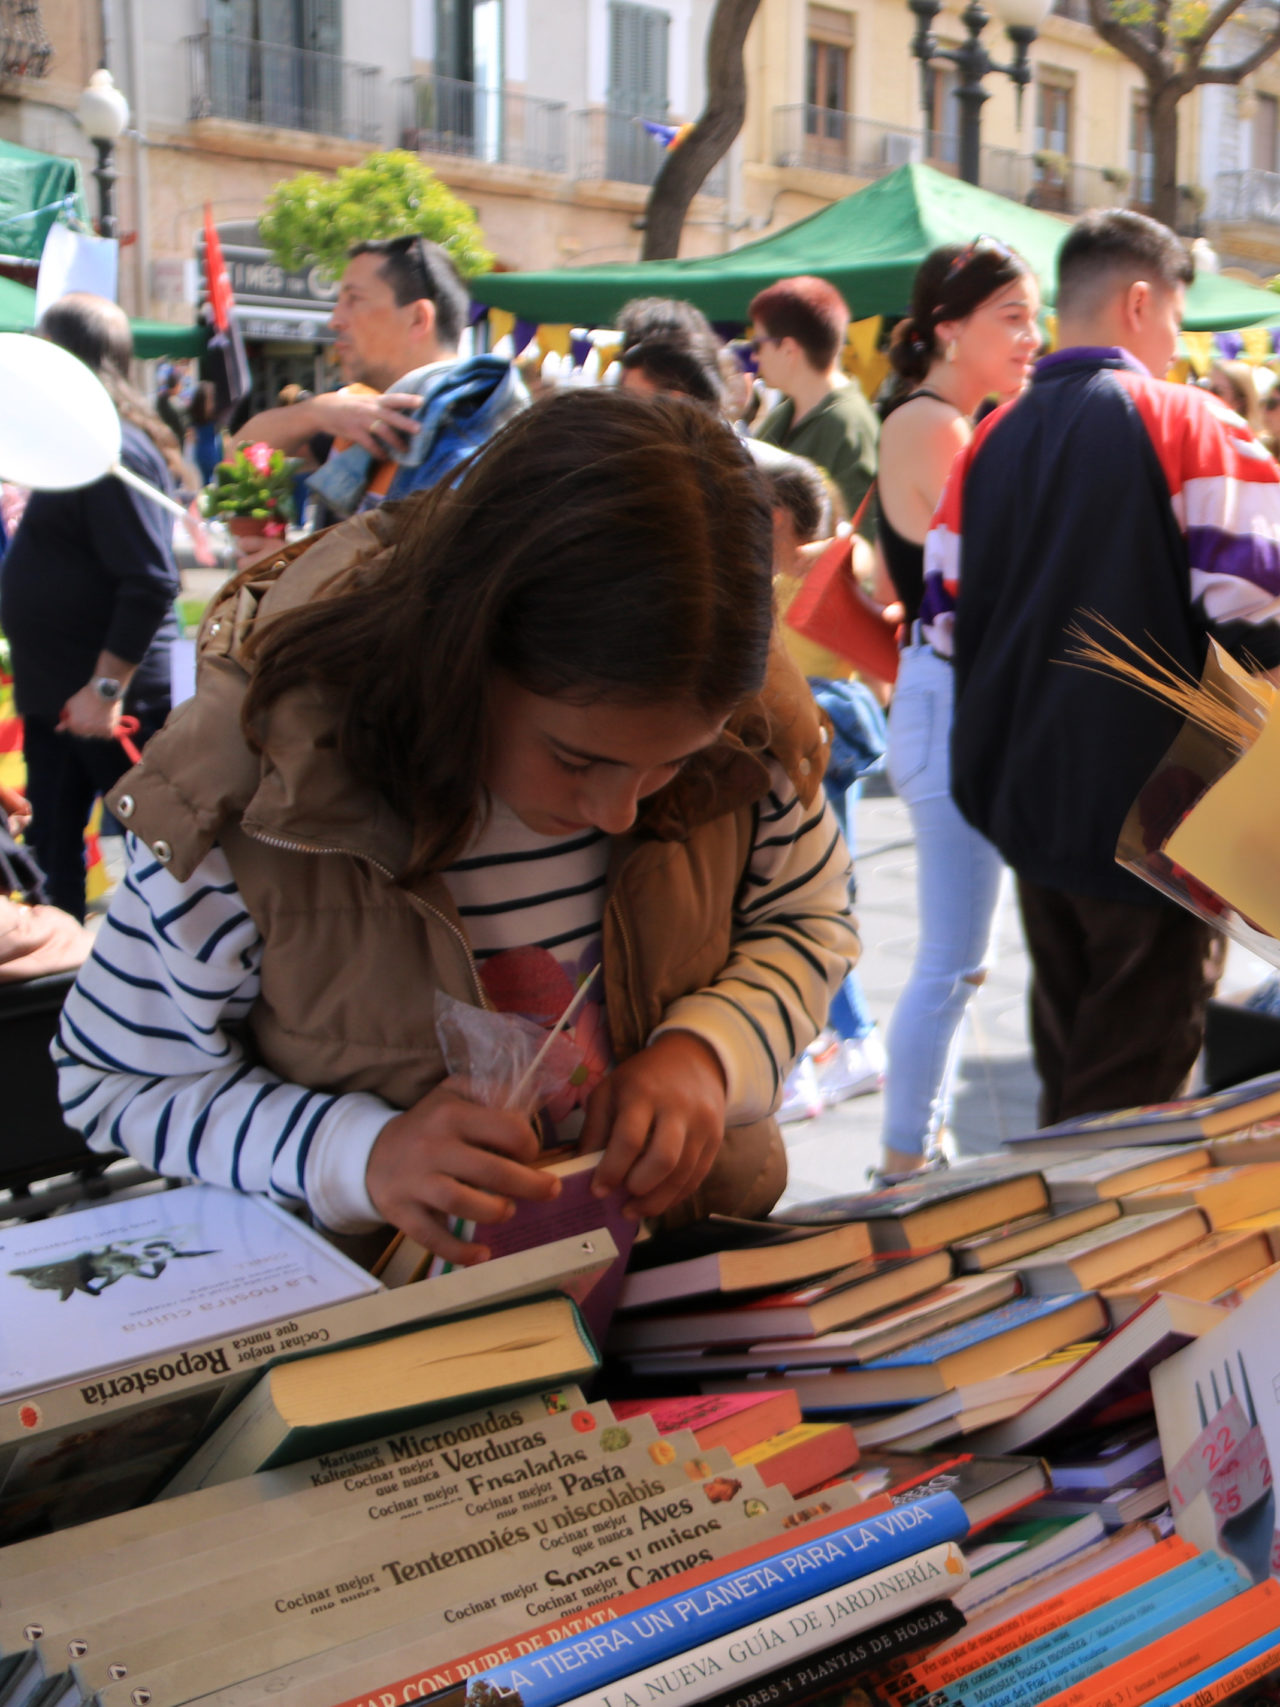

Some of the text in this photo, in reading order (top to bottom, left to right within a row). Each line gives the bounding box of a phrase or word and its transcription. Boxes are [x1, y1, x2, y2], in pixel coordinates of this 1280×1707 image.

[199, 1285, 280, 1312] nostra
[282, 1274, 320, 1288] La
[121, 1308, 192, 1333] cuina
[232, 1320, 300, 1350] que nunca
[237, 1327, 330, 1365] Cocinar mejor
[80, 1347, 232, 1406] Repostería
[387, 1407, 525, 1463] Microondas
[440, 1430, 548, 1473] Verduras
[310, 1456, 387, 1488] Kaltenbach
[318, 1444, 380, 1471] Marianne
[344, 1456, 436, 1492] Cocinar mejor
[466, 1448, 589, 1498] Ensaladas
[402, 1469, 440, 1490] nunca
[465, 1493, 515, 1518] Cocinar
[517, 1479, 553, 1503] mejor
[558, 1460, 627, 1498] Pasta
[368, 1496, 419, 1521] Cocinar
[423, 1483, 460, 1503] mejor
[638, 1498, 695, 1531] Aves
[539, 1513, 628, 1552] Cocinar mejor
[571, 1525, 635, 1558] que nunca
[381, 1525, 531, 1587] Tentempiés
[626, 1548, 715, 1590] Carnes
[274, 1571, 377, 1614] Cocinar mejor
[443, 1580, 540, 1624] Cocinar mejor
[493, 1504, 934, 1698] LA TIERRA UN PLANETA PARA LA VIDA
[525, 1575, 619, 1619] Cocinar mejor
[644, 1654, 724, 1701] NUEVA
[728, 1621, 786, 1664] GUÍA
[787, 1609, 824, 1638] DE
[826, 1556, 942, 1629] JARDINERÍA
[725, 1609, 948, 1707] ORES Y PLANTAS DE HOGAR
[402, 1669, 453, 1703] CON
[973, 1673, 1016, 1703] Monstre
[1015, 1658, 1048, 1680] busca
